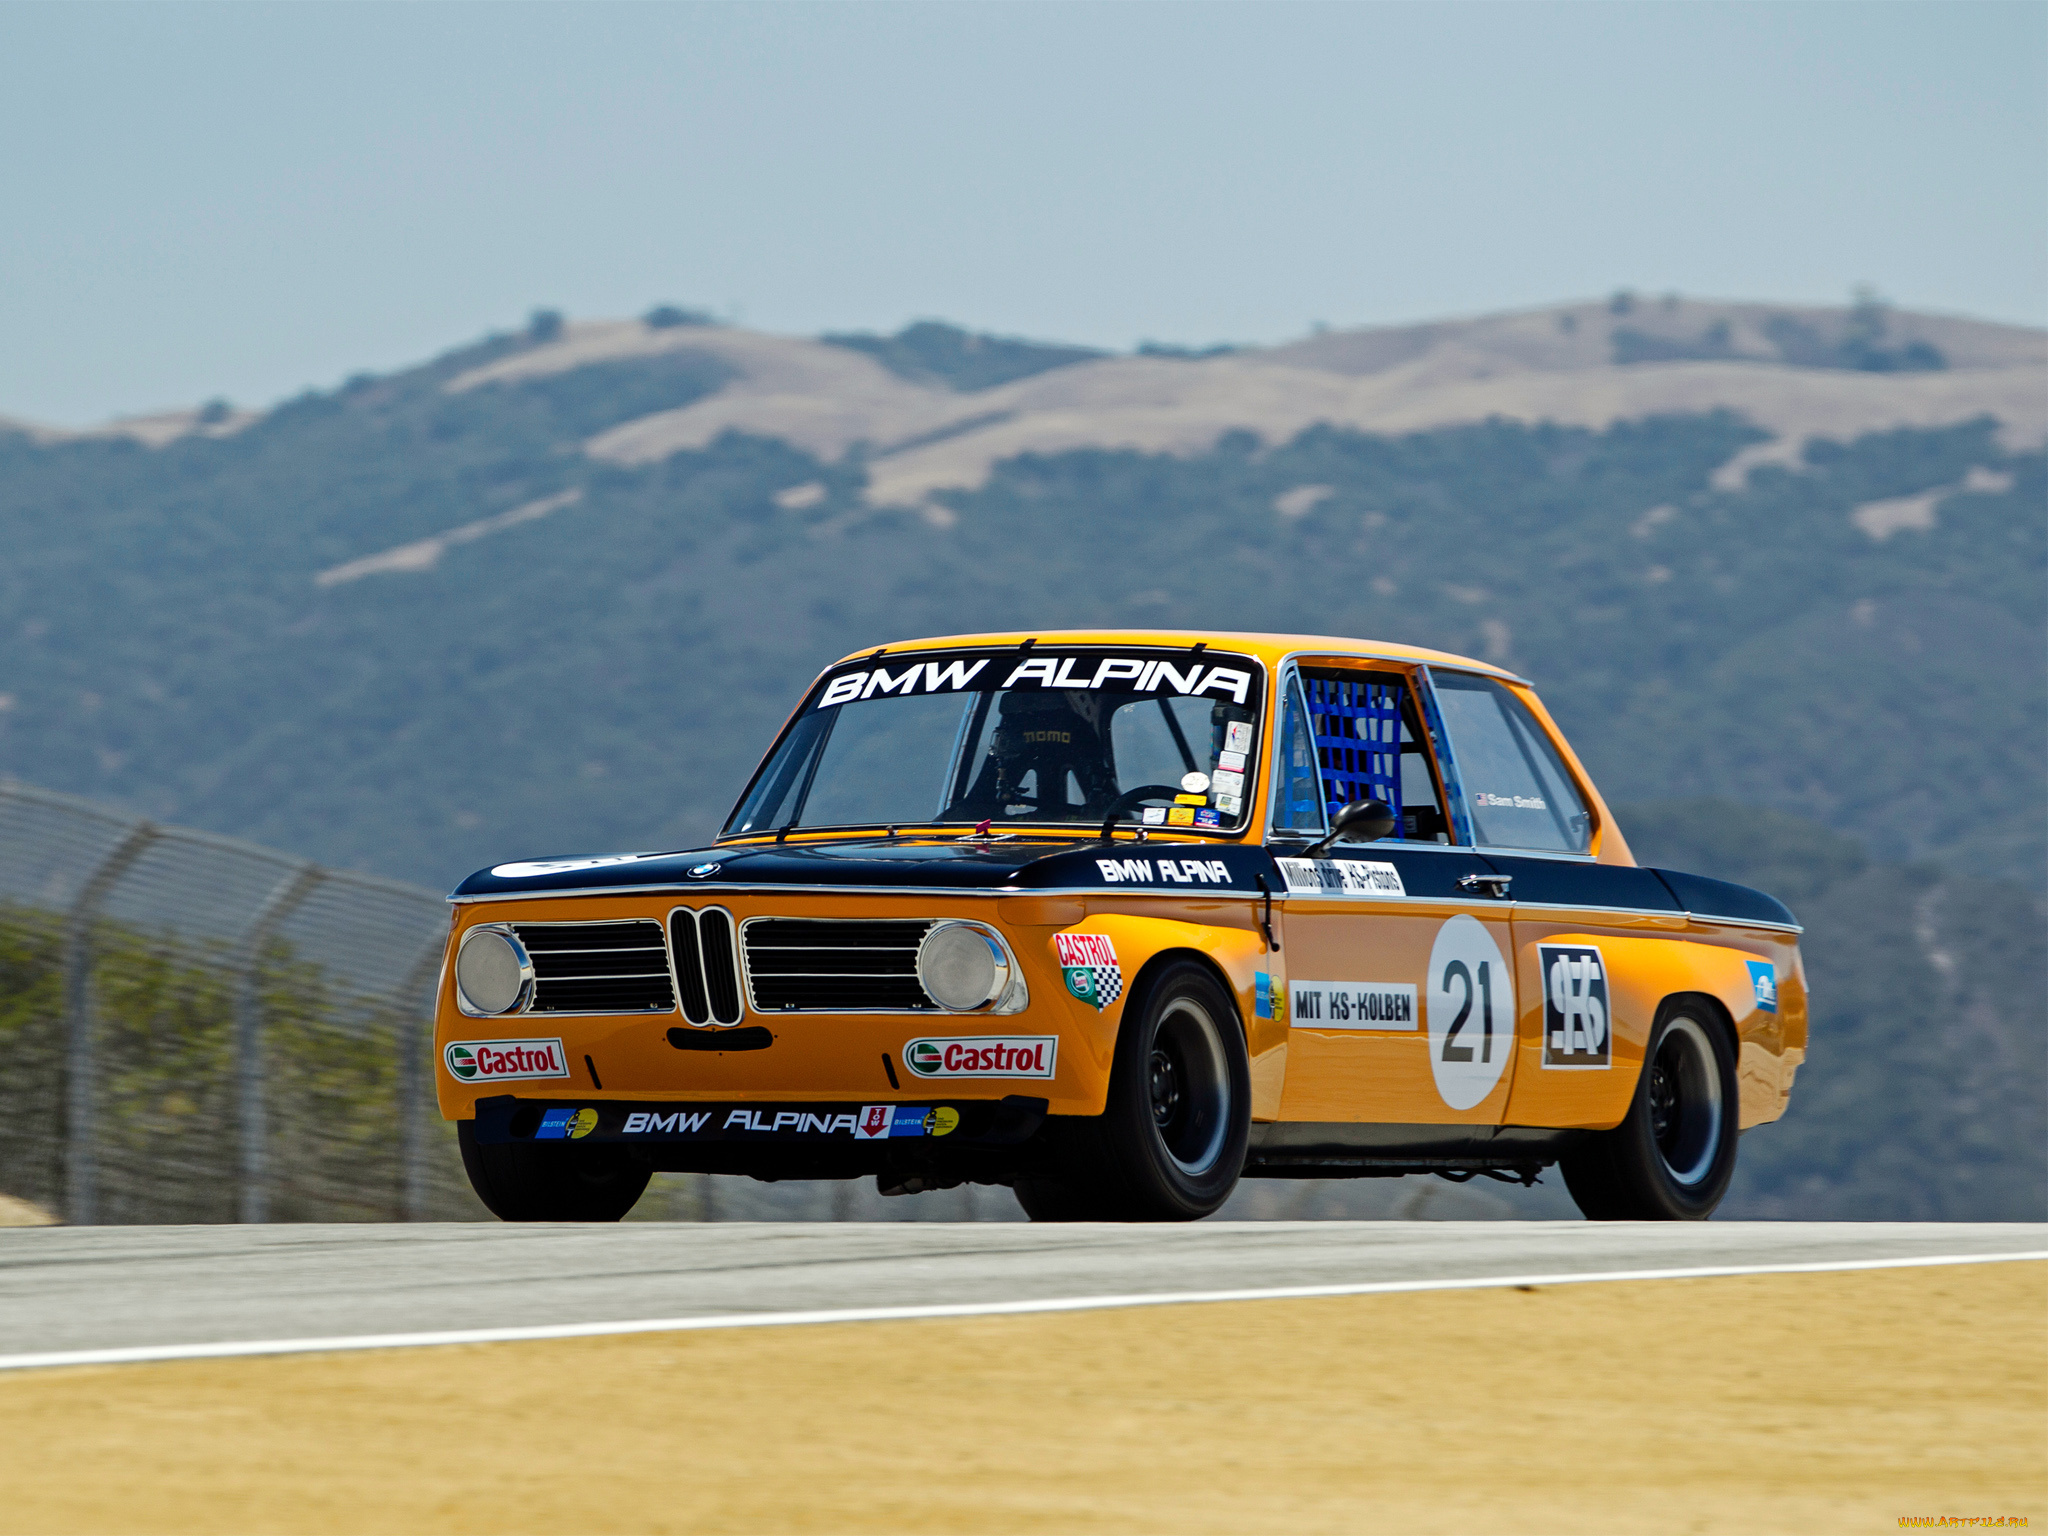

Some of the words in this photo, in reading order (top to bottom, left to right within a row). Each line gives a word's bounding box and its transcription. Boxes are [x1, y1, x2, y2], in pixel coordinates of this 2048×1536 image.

[818, 658, 990, 709] BMW
[1002, 658, 1251, 704] ALPINA
[1096, 859, 1153, 883] BMW
[1157, 860, 1233, 884] ALPINA
[1055, 934, 1118, 966] CASTROL
[1296, 990, 1322, 1019] MIT
[1329, 991, 1411, 1022] KS-KOLBEN
[1442, 959, 1493, 1064] 21
[477, 1045, 560, 1075] Castrol
[944, 1042, 1045, 1071] Castrol
[622, 1112, 711, 1133] BMW
[723, 1109, 858, 1134] ALPINA
[870, 1108, 882, 1127] TOW
